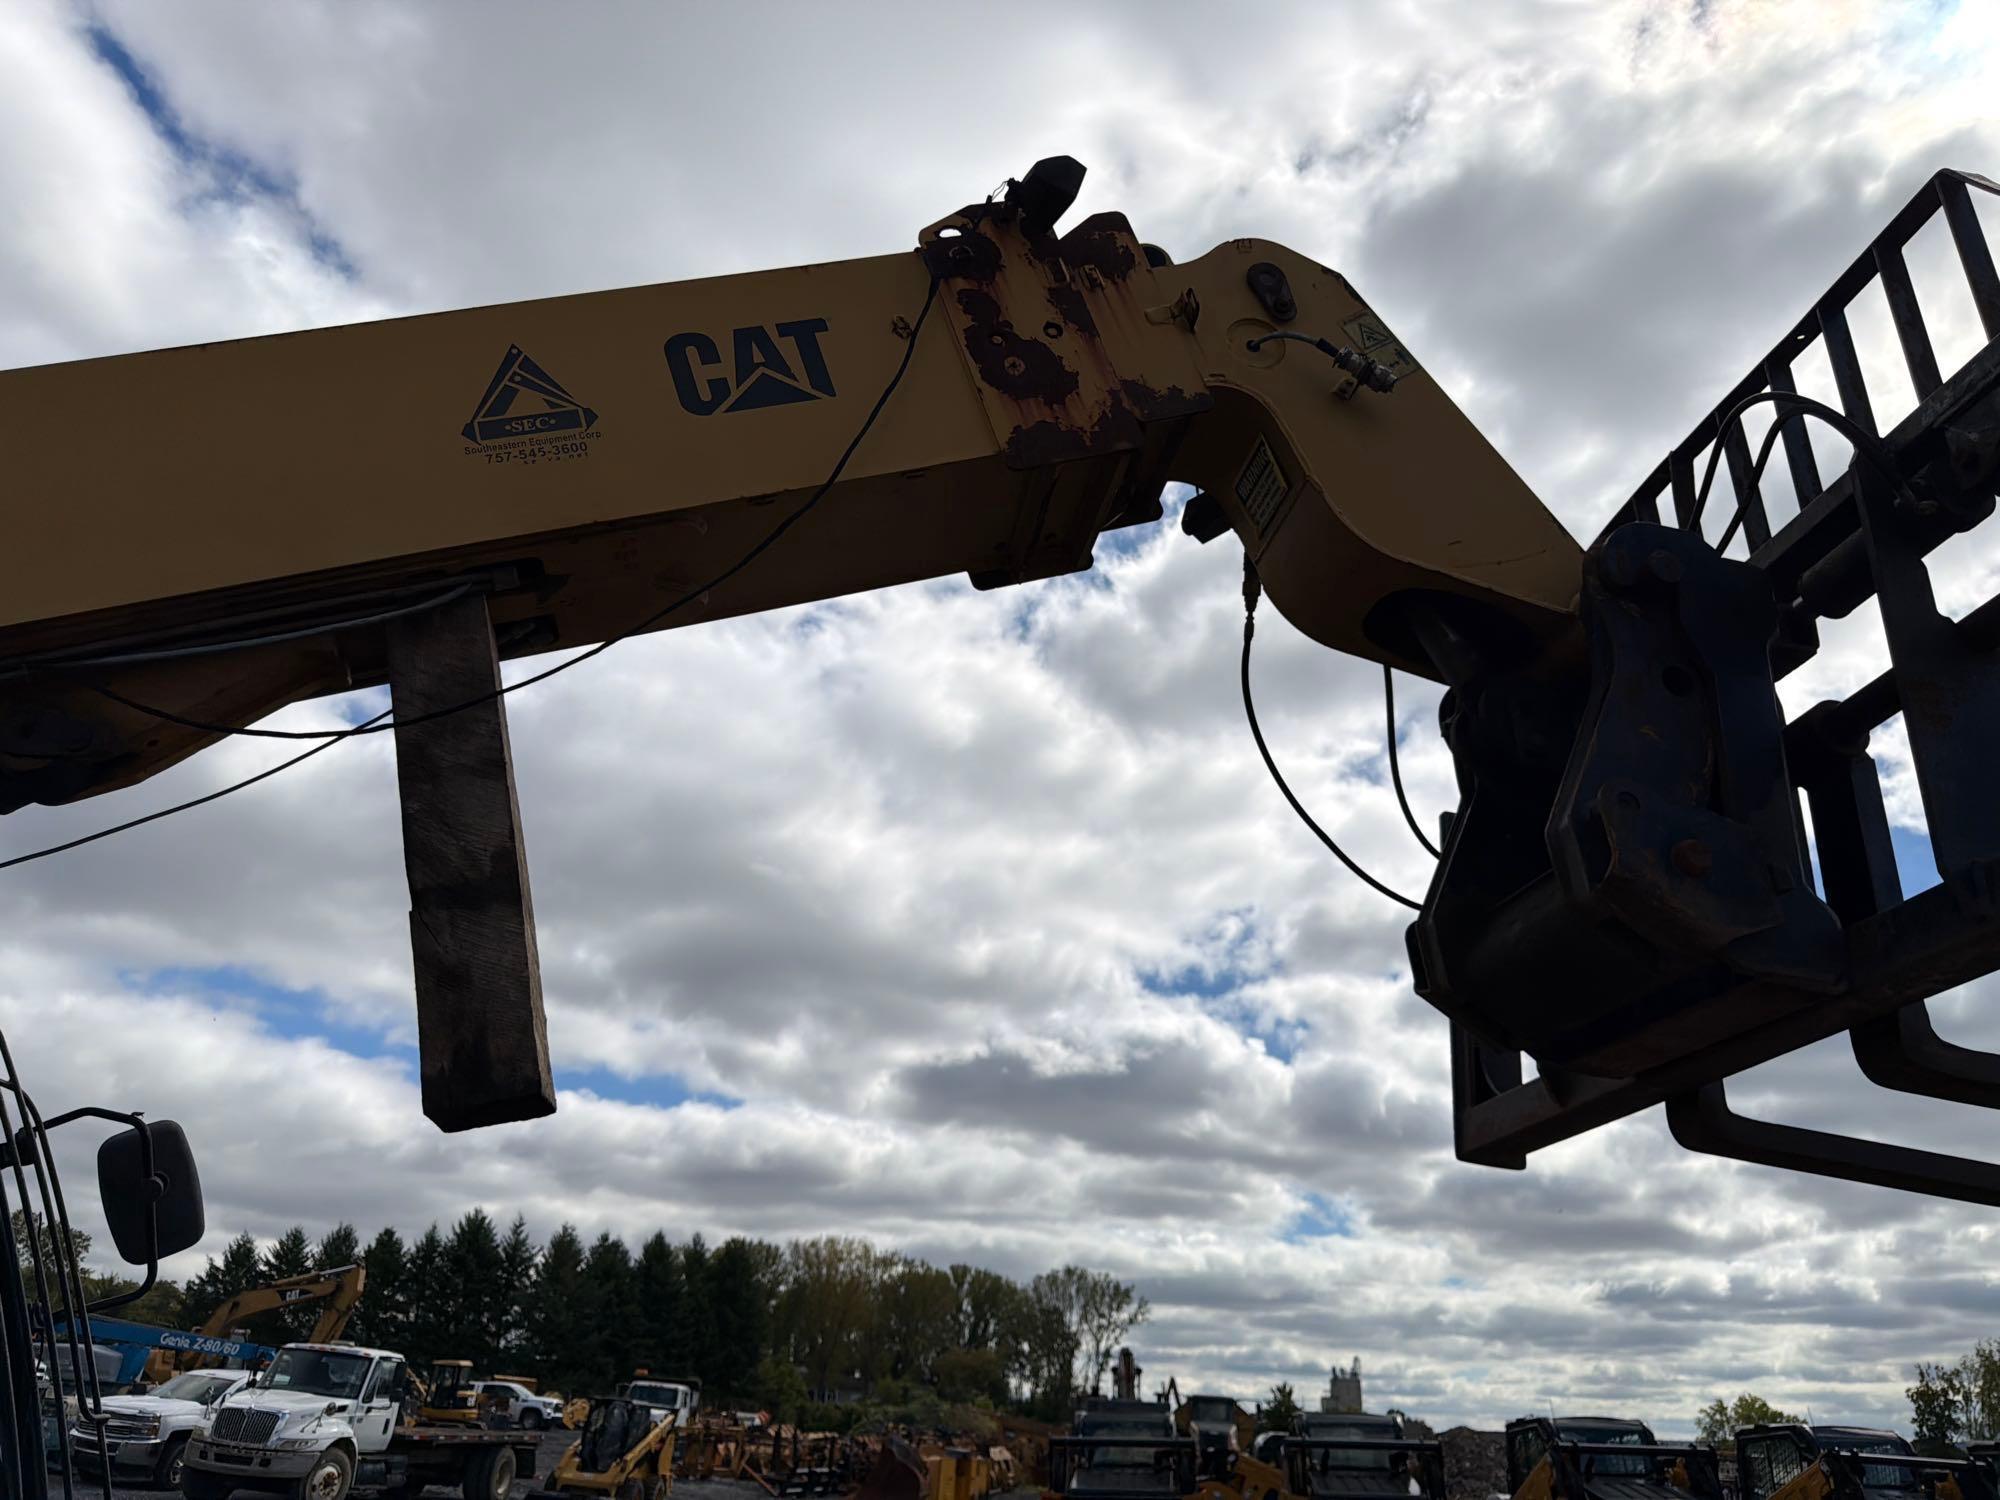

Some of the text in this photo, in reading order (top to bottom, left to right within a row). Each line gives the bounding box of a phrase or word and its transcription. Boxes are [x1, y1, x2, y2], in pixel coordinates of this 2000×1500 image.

[664, 317, 836, 416] CAT
[464, 441, 527, 455] Southeastern
[528, 433, 577, 447] Equipment
[486, 442, 588, 464] 757-545-3600
[160, 1332, 240, 1356] Genie Z-80/60
